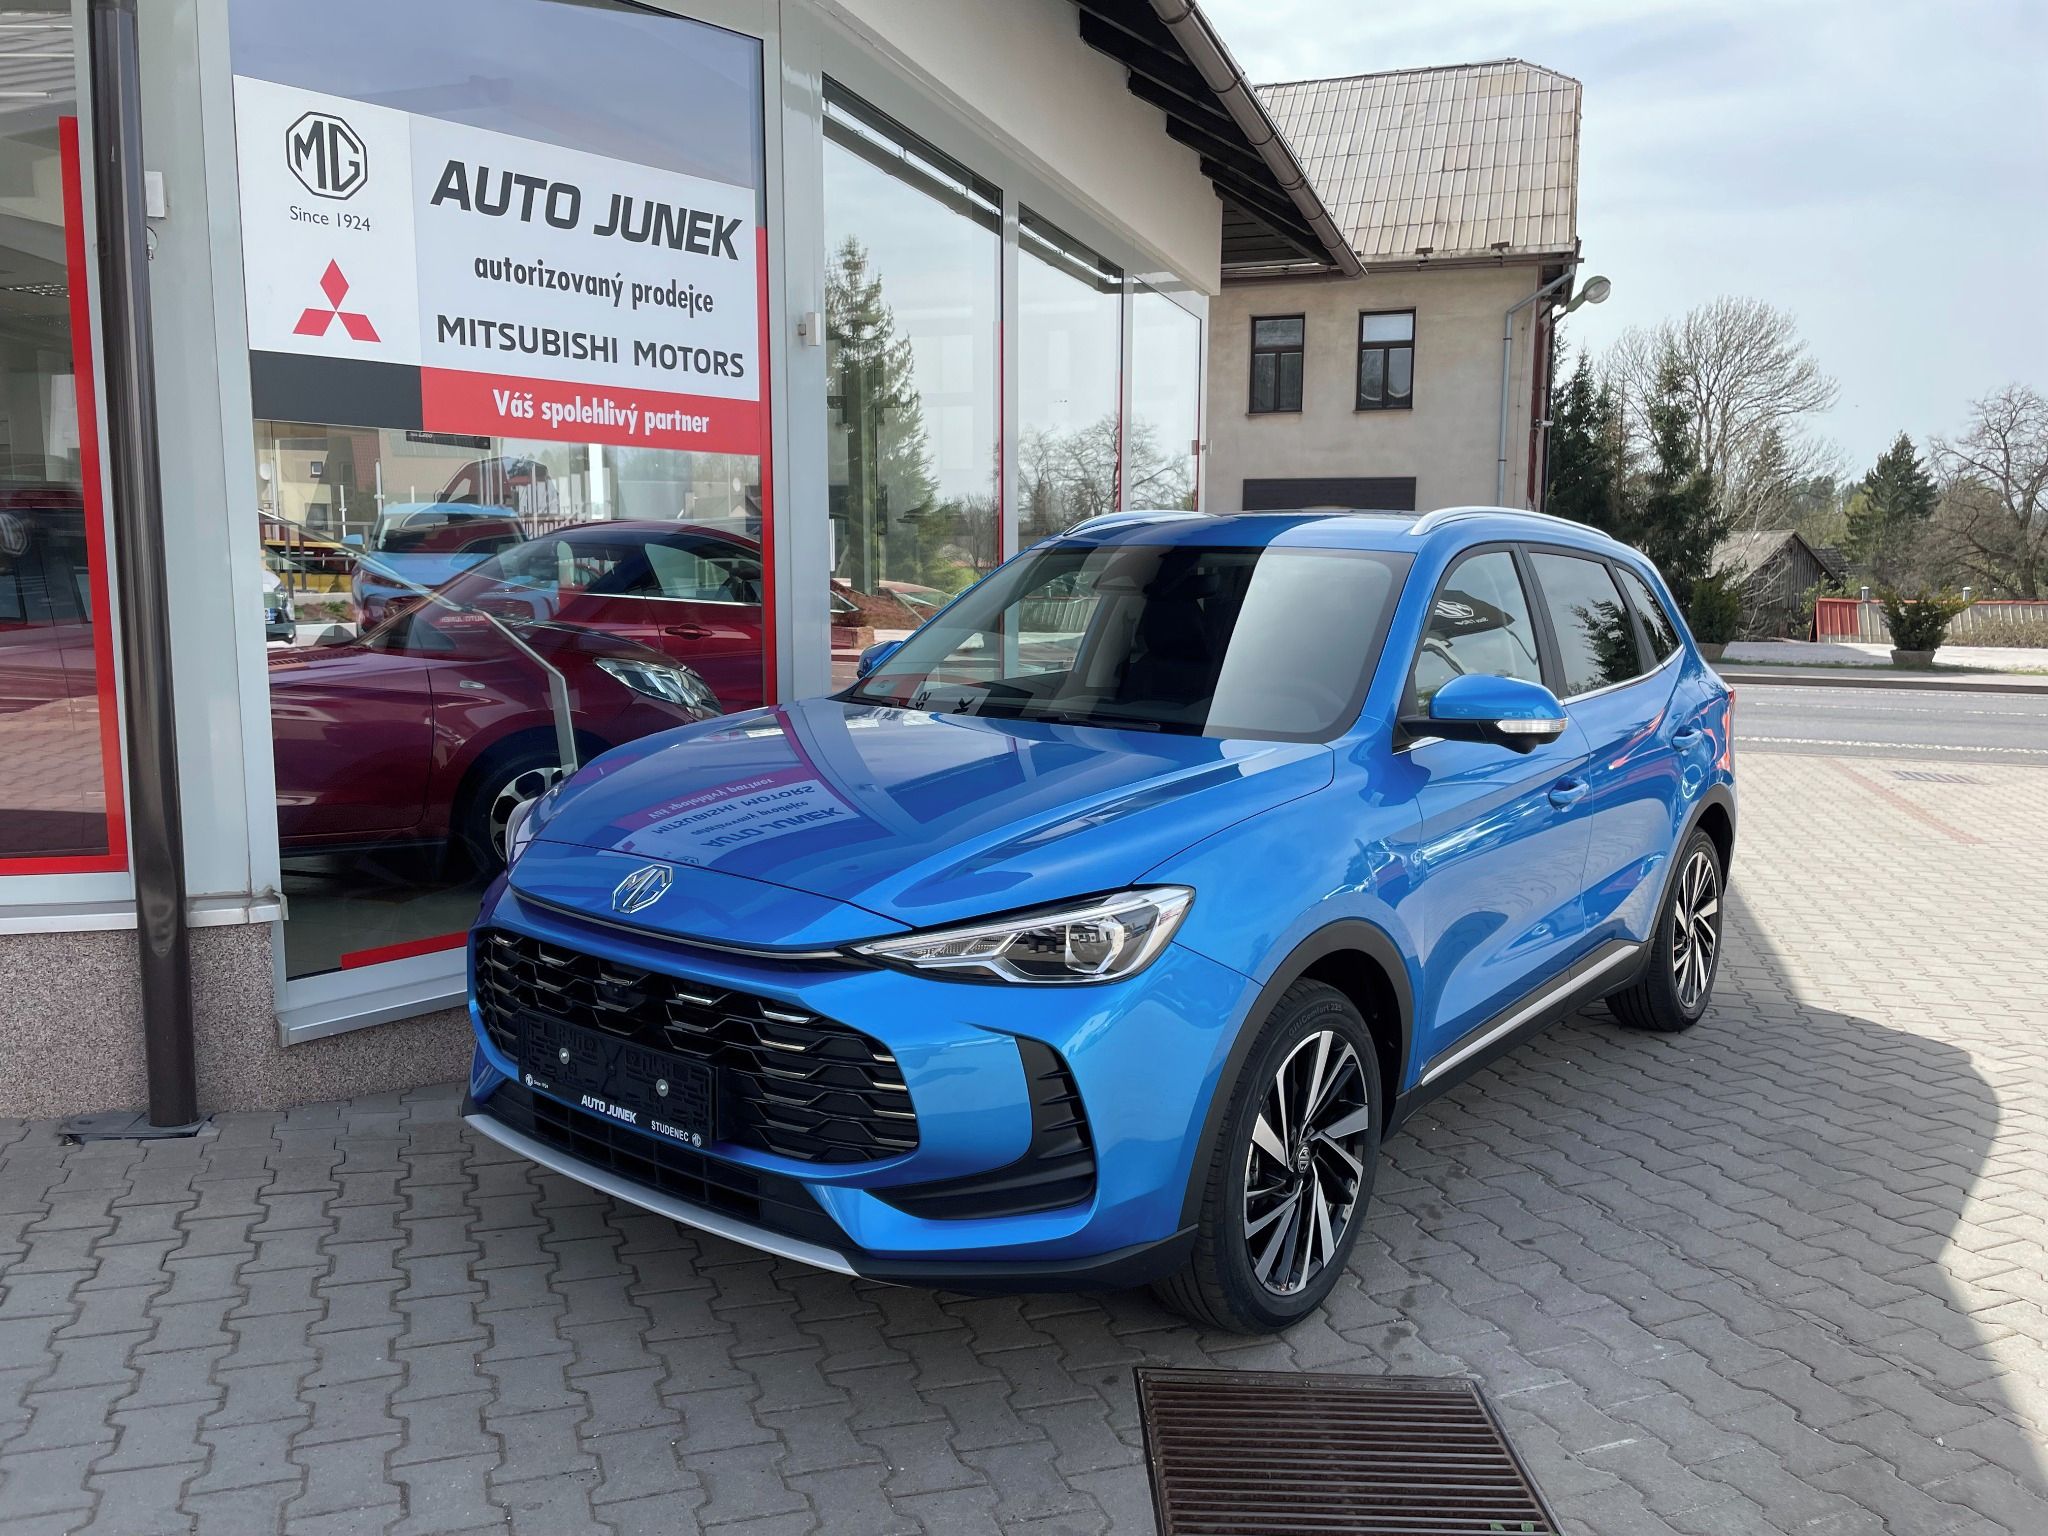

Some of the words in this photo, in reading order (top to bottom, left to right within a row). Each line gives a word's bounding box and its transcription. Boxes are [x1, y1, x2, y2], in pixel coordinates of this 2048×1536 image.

[288, 115, 365, 197] MG
[289, 206, 330, 226] Since
[336, 212, 371, 232] 1924
[430, 160, 582, 230] AUTO
[593, 194, 743, 260] JUNEK
[474, 256, 623, 307] autorizovaný
[632, 280, 714, 318] prodejce
[438, 315, 618, 364] MITSUBISHI
[634, 340, 744, 378] MOTORS
[492, 389, 534, 419] Váš
[541, 400, 638, 434] spolehlivý
[644, 412, 710, 435] partner
[613, 863, 673, 914] MG
[581, 1094, 606, 1113] AUTO
[606, 1104, 637, 1124] JUNEK
[651, 1120, 689, 1142] STUDENEC
